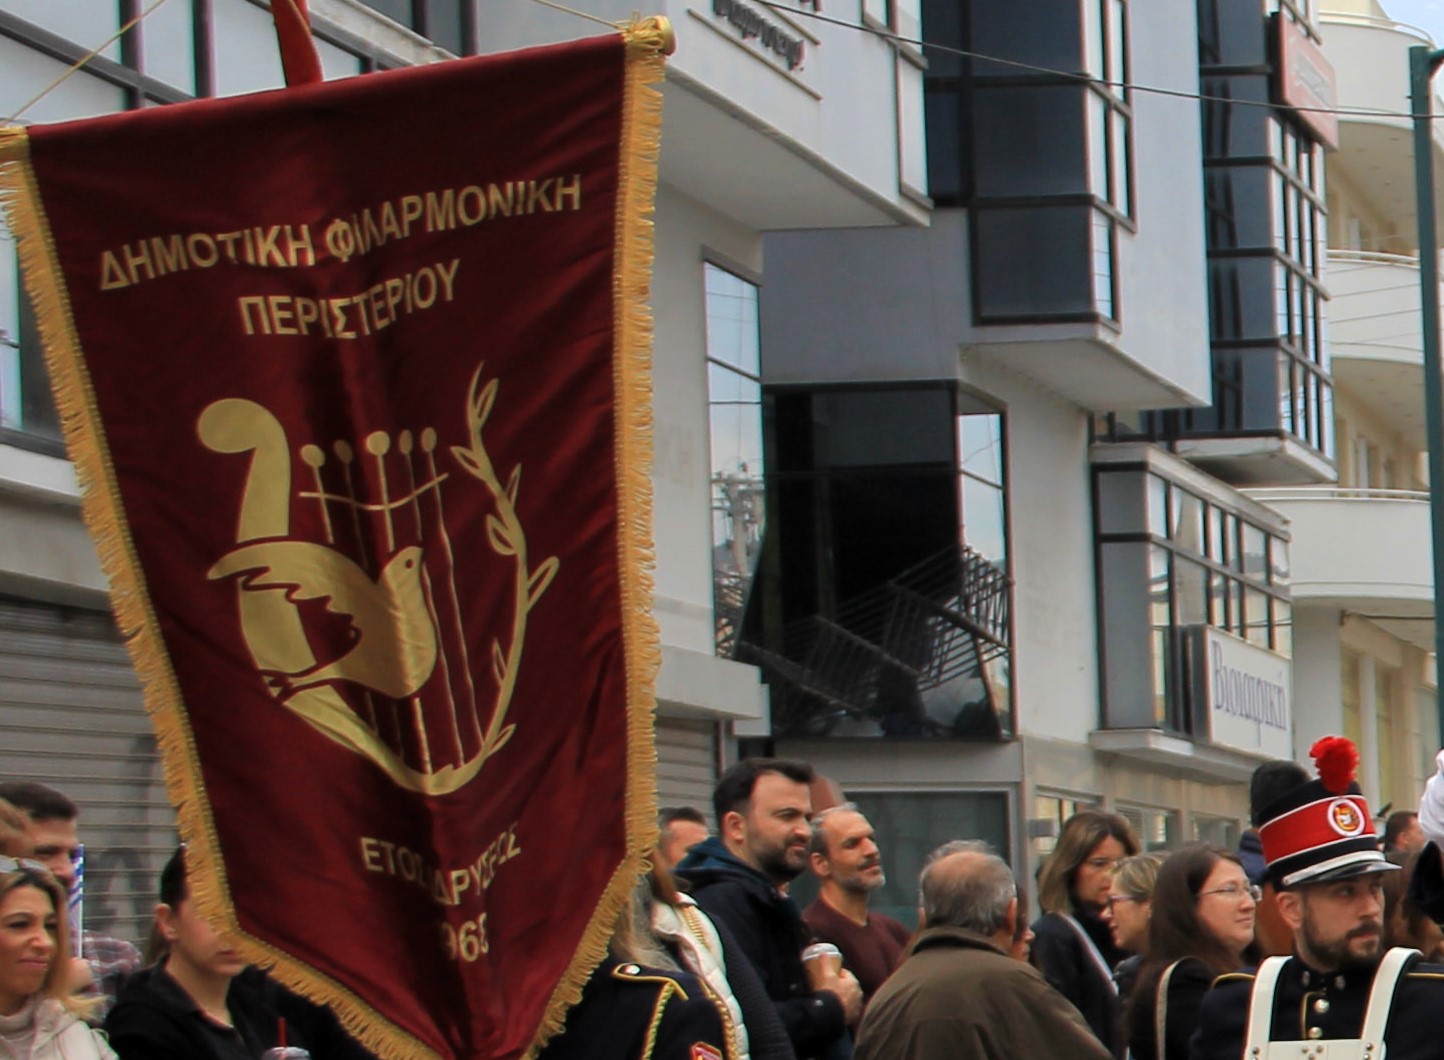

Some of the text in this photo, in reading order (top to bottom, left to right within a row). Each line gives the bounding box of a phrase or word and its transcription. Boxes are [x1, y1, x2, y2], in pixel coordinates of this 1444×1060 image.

[100, 174, 582, 291] ΔΗΜΟΤΙΚΗ ΦΙΛΑΡΜΟΝΙΚΗ
[237, 258, 461, 340] ΠΕΡΙΣΤΕΡΙΟΥ
